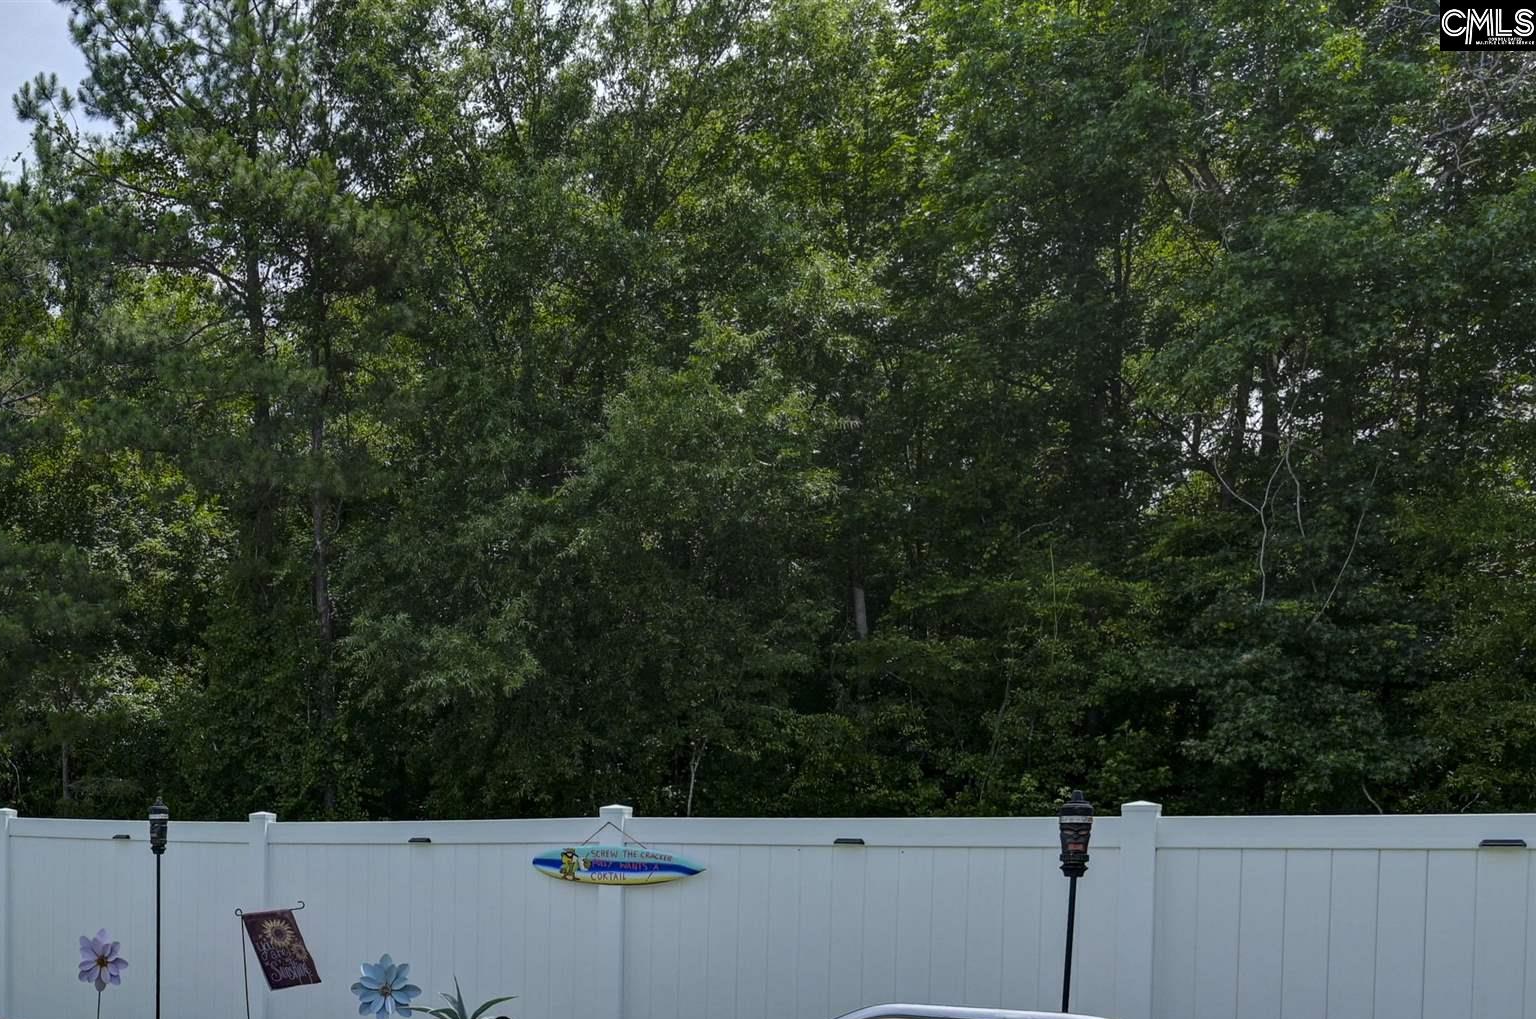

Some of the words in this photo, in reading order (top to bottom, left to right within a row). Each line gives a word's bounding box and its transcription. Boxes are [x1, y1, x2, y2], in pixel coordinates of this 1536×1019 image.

[591, 849, 617, 858] SCREW
[623, 850, 638, 858] THE
[640, 851, 672, 862] CRACKER
[619, 862, 647, 870] WANTS
[590, 871, 626, 881] COKTAIL
